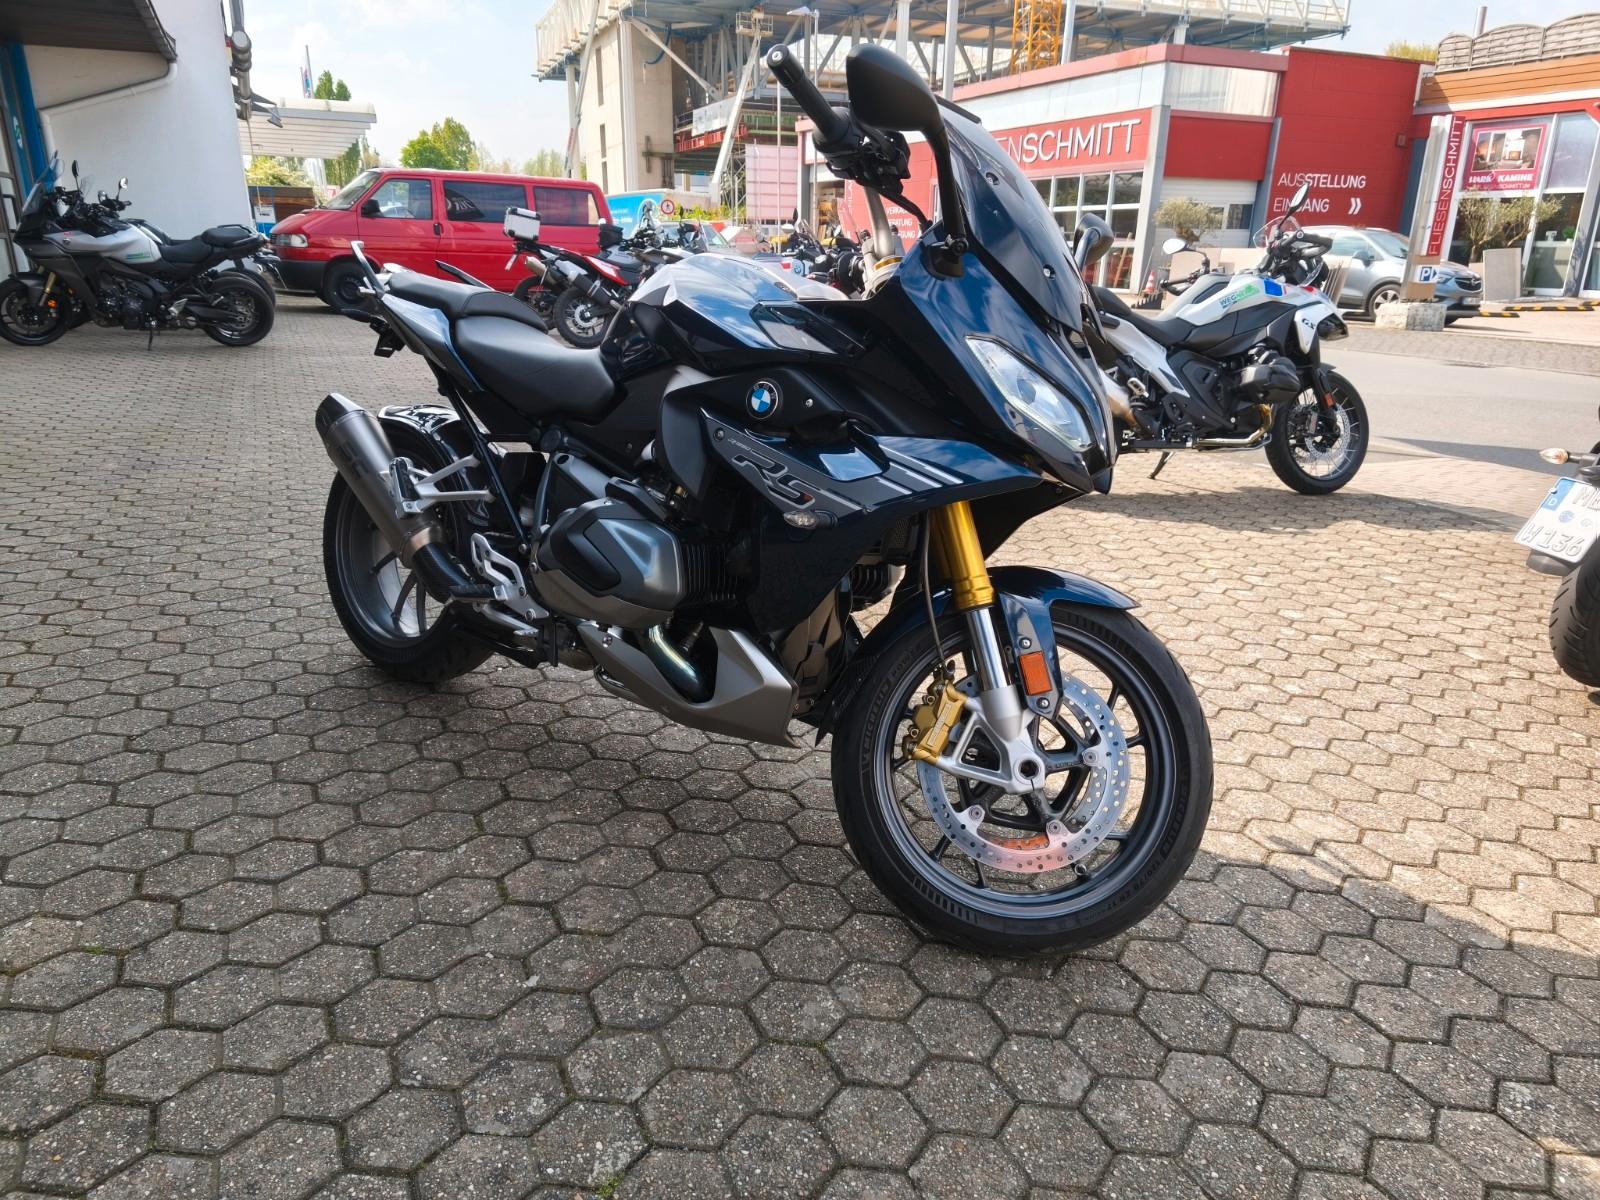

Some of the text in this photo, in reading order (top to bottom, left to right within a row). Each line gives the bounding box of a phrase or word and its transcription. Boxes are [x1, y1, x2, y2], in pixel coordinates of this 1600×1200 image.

[996, 119, 1141, 163] NSCHMITT
[1277, 173, 1366, 188] AUSSTELLUNG
[1429, 117, 1463, 255] FLIESENSCHMITT
[1273, 198, 1330, 212] EINANG
[1422, 267, 1430, 280] P
[732, 453, 816, 510] RS
